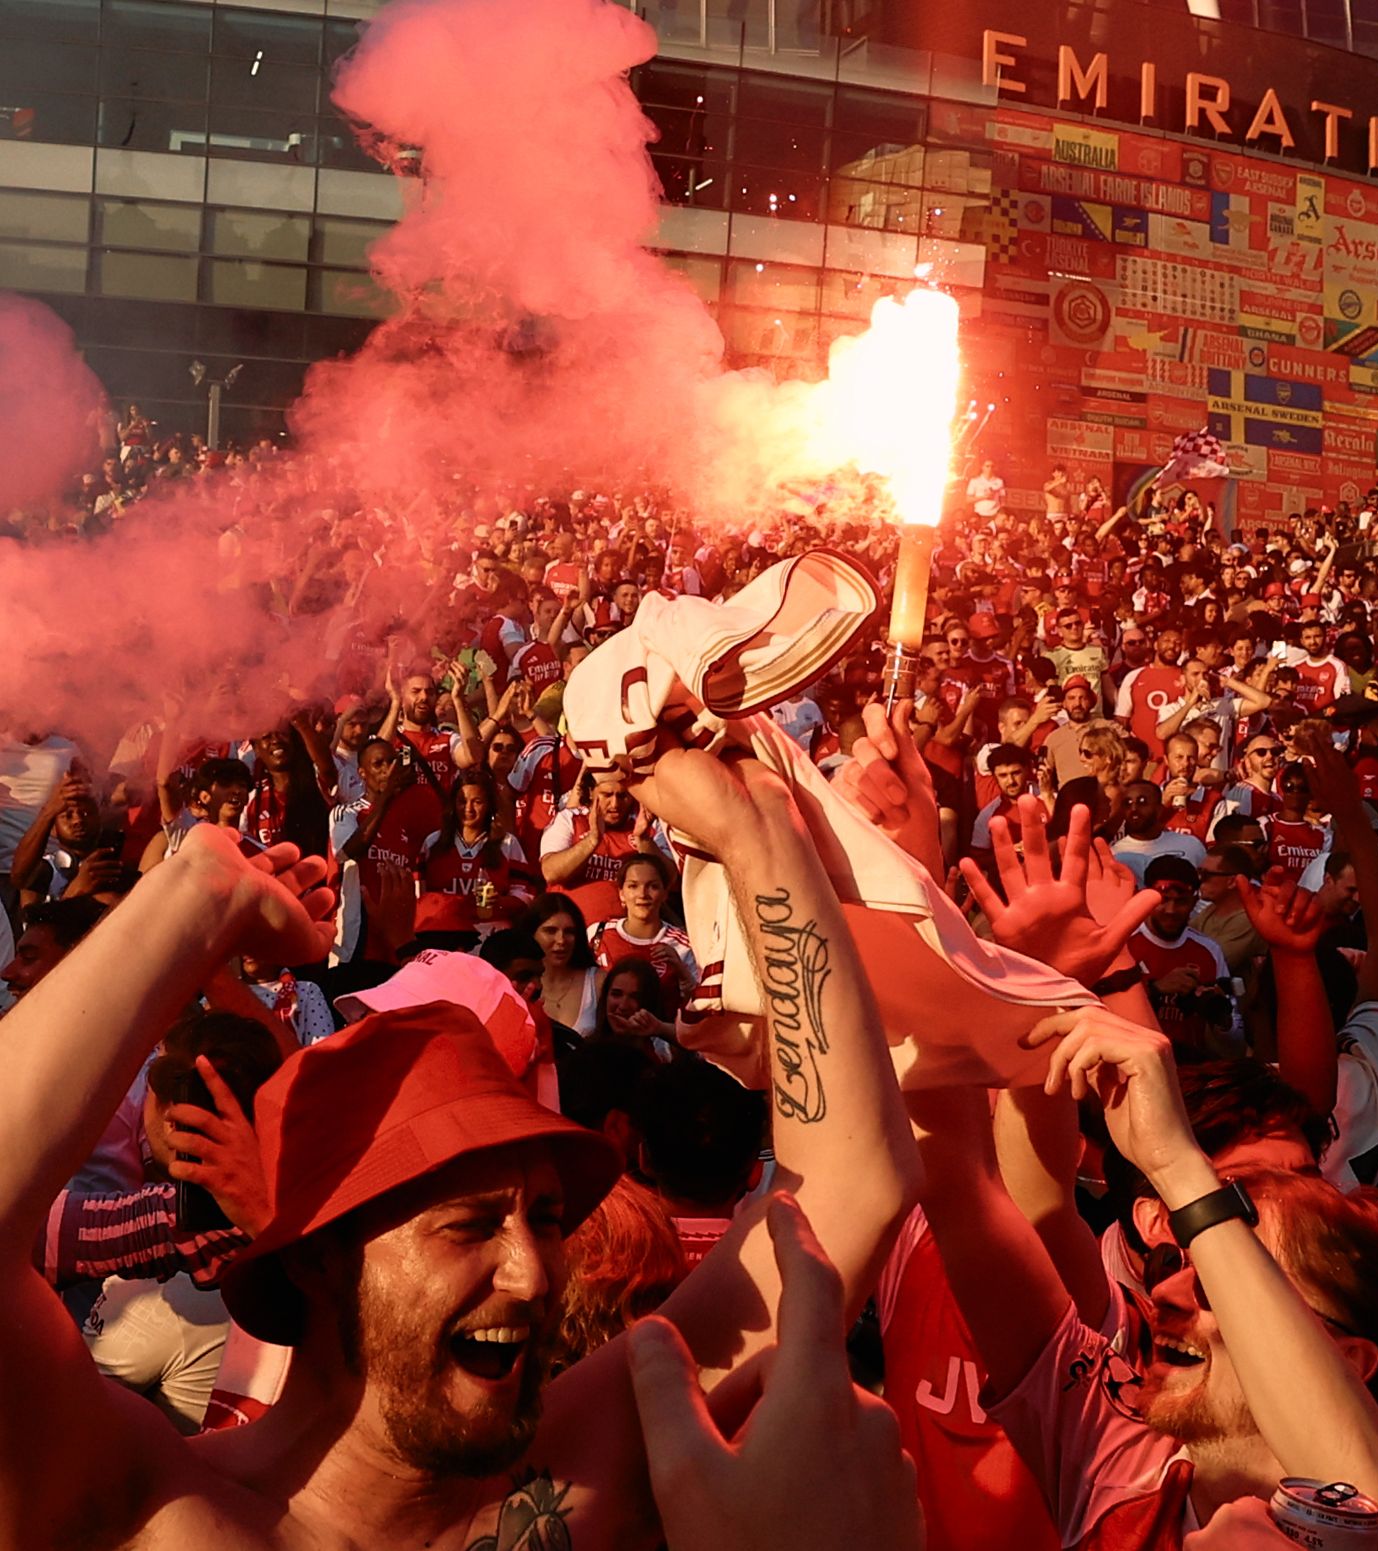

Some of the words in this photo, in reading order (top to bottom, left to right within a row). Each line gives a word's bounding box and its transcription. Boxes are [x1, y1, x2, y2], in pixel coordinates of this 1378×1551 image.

[1054, 139, 1116, 171] AUSTRALIA
[1237, 167, 1260, 180] EAST
[1041, 166, 1097, 199] ARSENAL
[1100, 176, 1140, 206] FAROE
[1142, 183, 1192, 215] ISLANDS
[1244, 181, 1288, 200] ARSENAL
[1243, 303, 1293, 320] ARSENAL
[1247, 328, 1288, 343] GHANA
[1269, 358, 1348, 384] GUNNERS
[1212, 400, 1269, 418] ARSENAL
[1271, 408, 1320, 424] SWEDEN
[1050, 446, 1111, 461] VIETNAM
[587, 853, 623, 869] mira
[756, 887, 822, 1123] Zendaya
